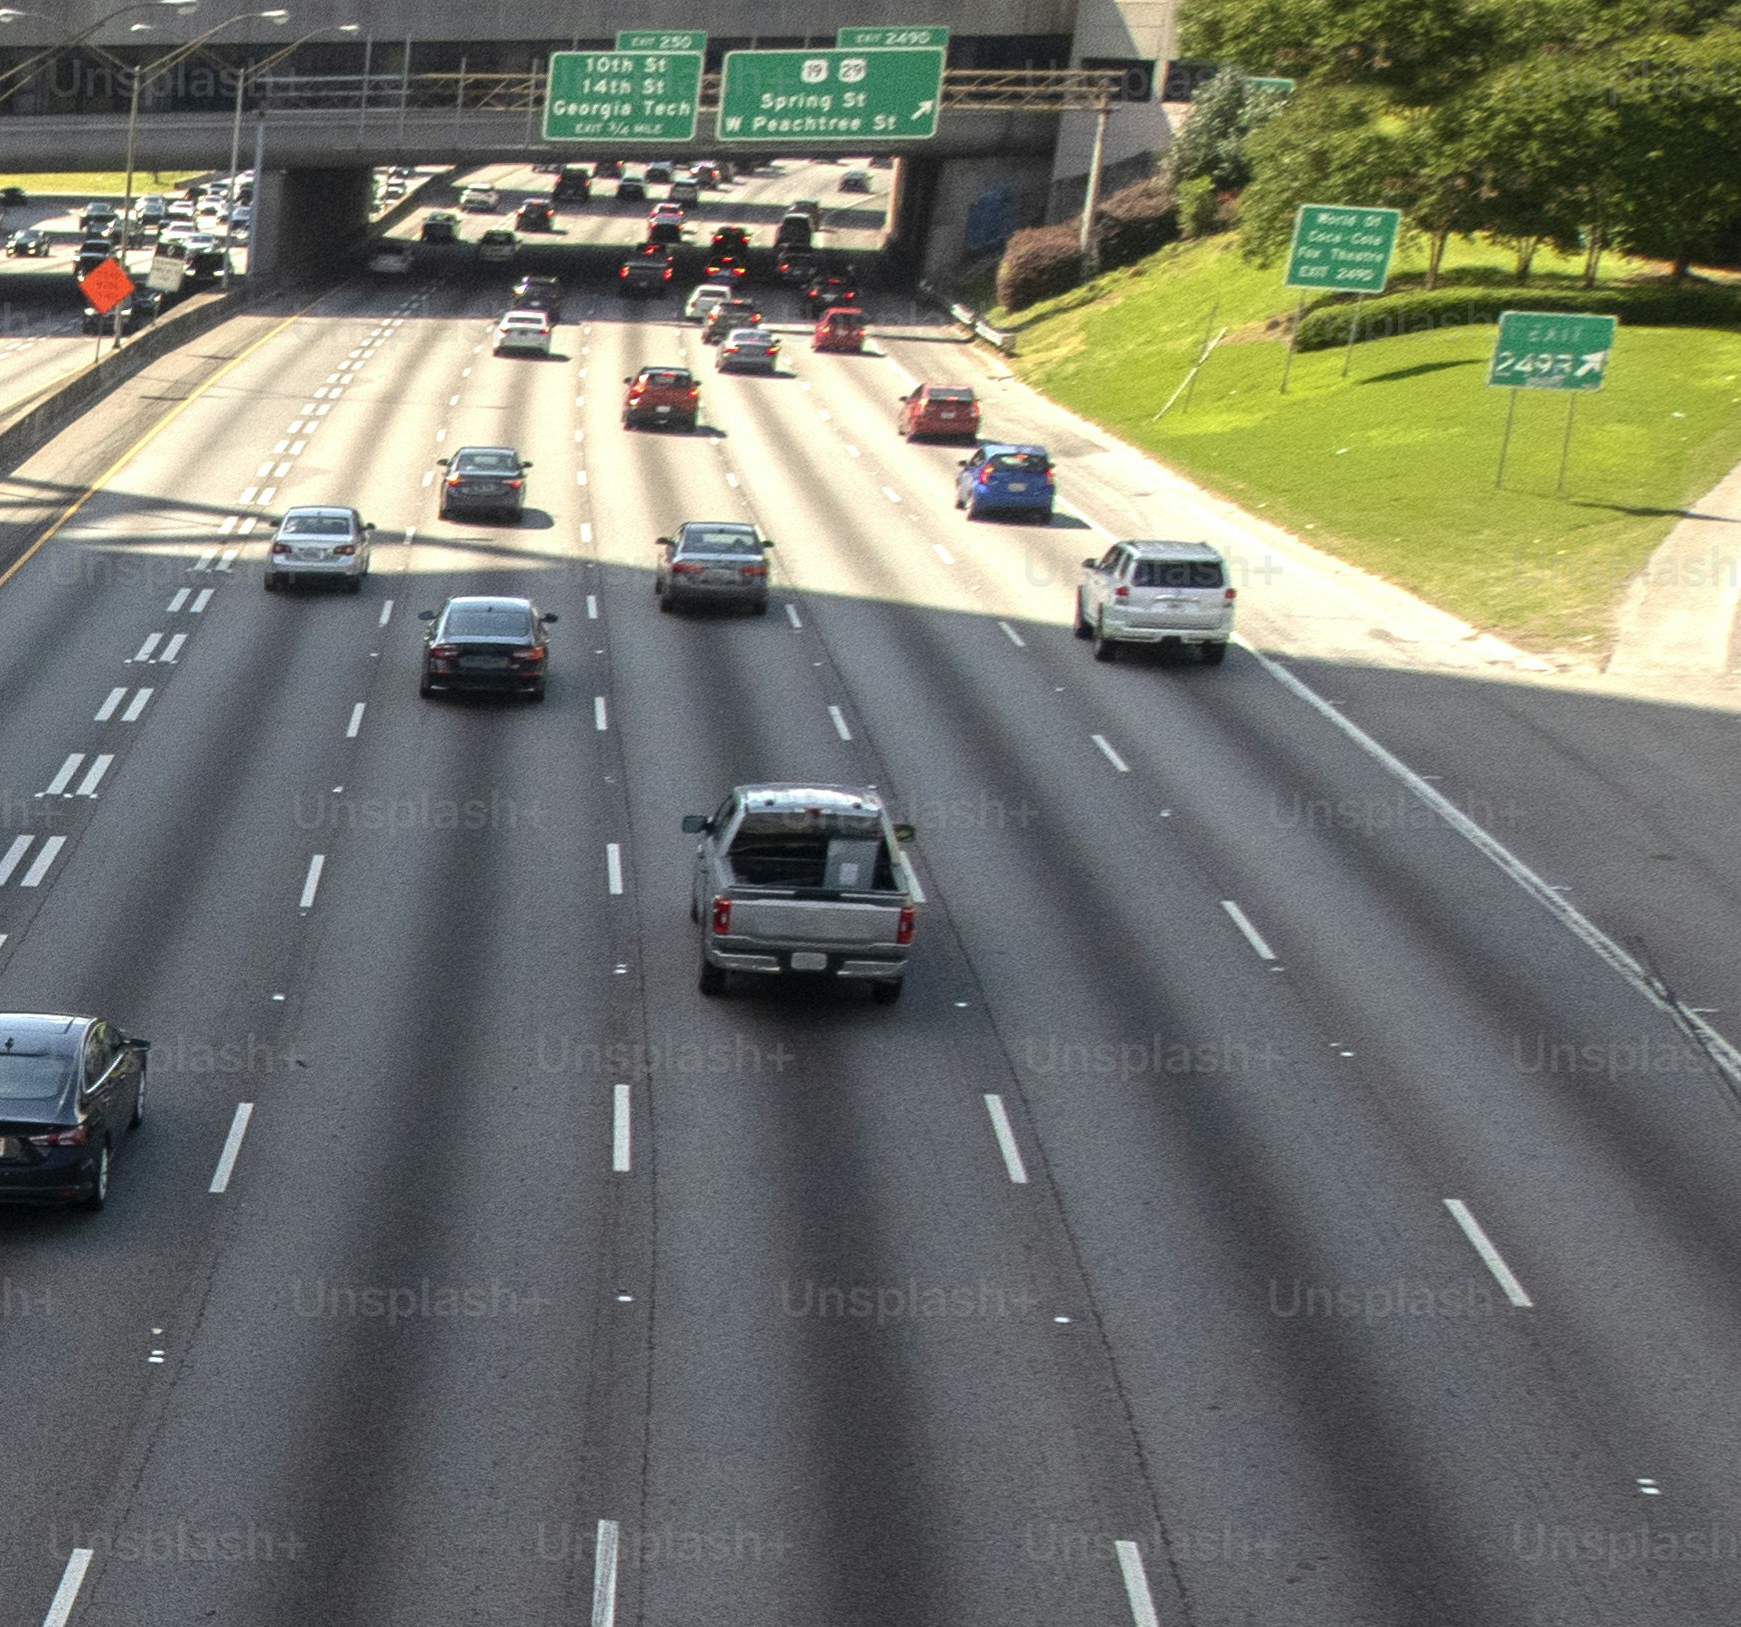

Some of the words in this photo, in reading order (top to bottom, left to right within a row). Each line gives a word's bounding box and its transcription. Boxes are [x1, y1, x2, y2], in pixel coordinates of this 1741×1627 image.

[659, 35, 692, 49] 250
[585, 57, 634, 73] 10th
[644, 57, 667, 73] St
[842, 63, 864, 78] 29
[582, 79, 632, 94] 14th
[641, 78, 666, 94] St
[759, 92, 834, 112] Spring
[842, 91, 868, 109] St
[552, 100, 633, 120] Georgia
[643, 100, 691, 116] Tech
[724, 116, 744, 132] W
[752, 115, 863, 132] Peachtree
[873, 114, 898, 131] St
